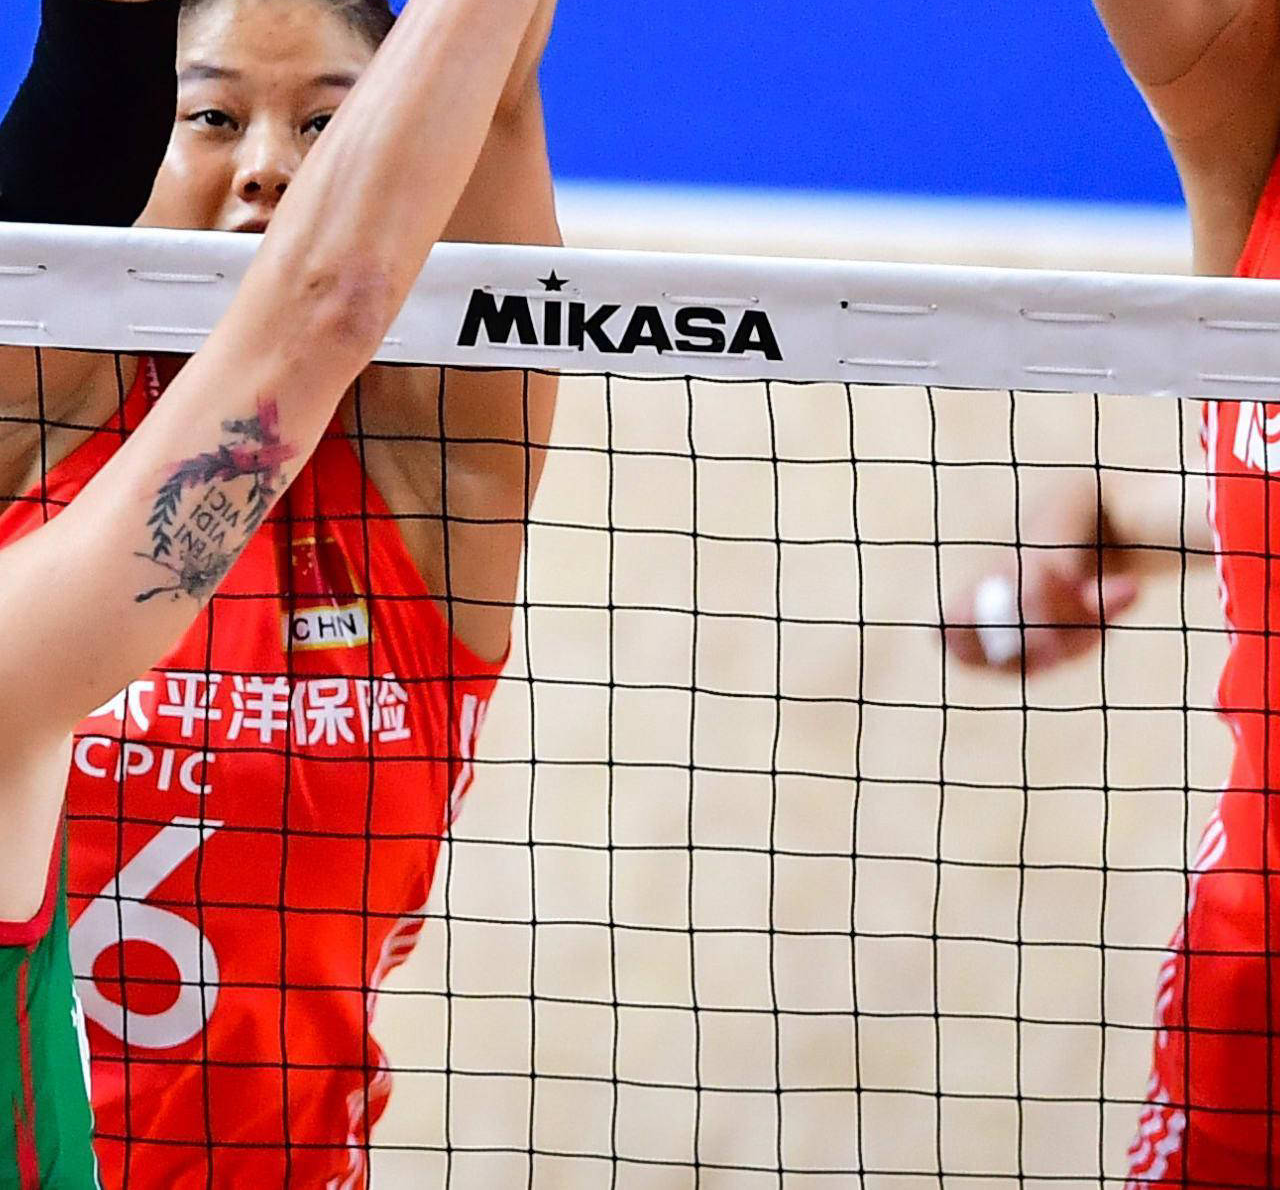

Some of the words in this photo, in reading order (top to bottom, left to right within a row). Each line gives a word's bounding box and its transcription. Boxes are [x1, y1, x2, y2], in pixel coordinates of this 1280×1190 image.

[456, 270, 784, 361] MIKASA
[189, 504, 226, 548] VIDI
[203, 486, 240, 527] VICI
[292, 613, 358, 641] CHN
[73, 737, 216, 795] CPIC
[68, 816, 224, 1049] 6
